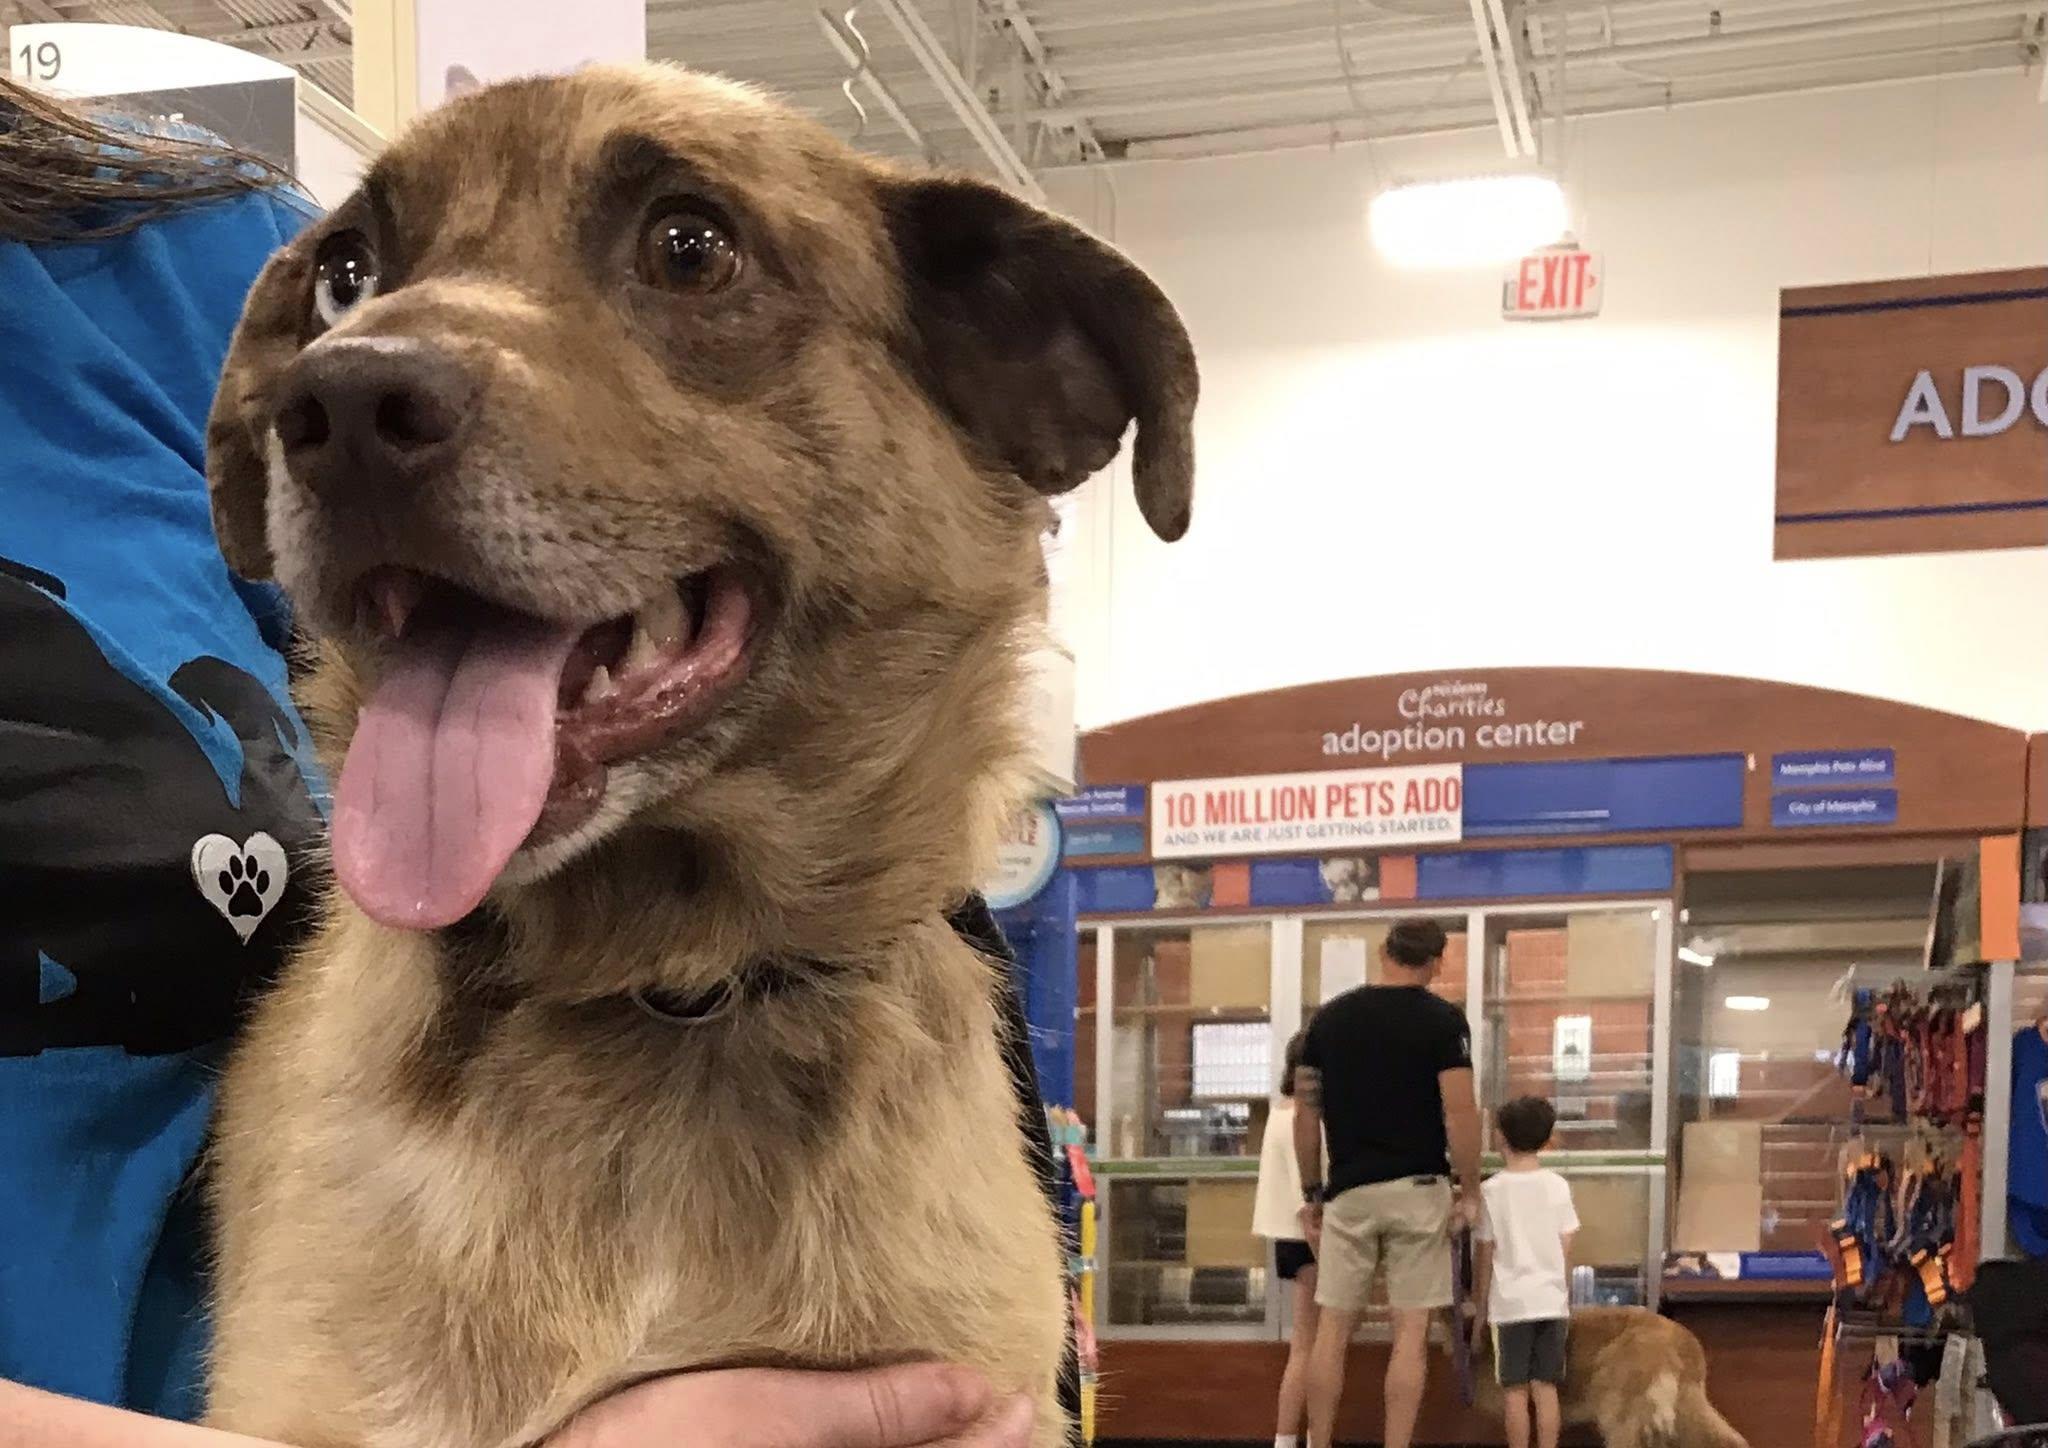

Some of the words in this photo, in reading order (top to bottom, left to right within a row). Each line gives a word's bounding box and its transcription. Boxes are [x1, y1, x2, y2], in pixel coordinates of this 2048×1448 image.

[19, 41, 62, 82] 19
[1517, 254, 1591, 310] EXIT
[1889, 365, 2048, 442] AD
[1398, 685, 1505, 719] Charities
[1322, 721, 1466, 761] adoption
[1475, 718, 1584, 749] center
[1165, 792, 1196, 828] 10
[1204, 785, 1317, 826] MILLION
[1325, 780, 1395, 819] PETS
[1403, 776, 1462, 815] ADO
[1164, 831, 1200, 847] AND
[1203, 828, 1227, 845] WE
[1230, 827, 1262, 843] ARE
[1267, 824, 1303, 841] JUST
[1305, 820, 1376, 839] GETTING
